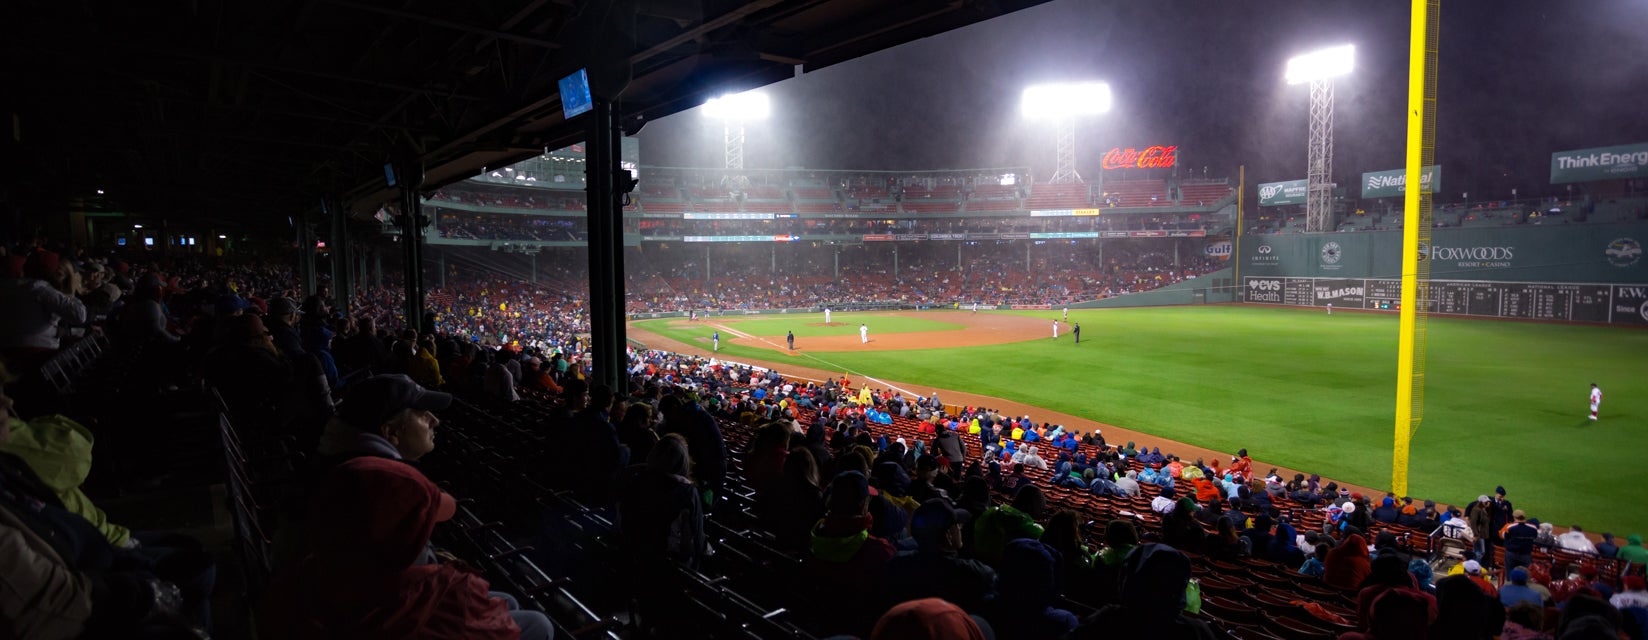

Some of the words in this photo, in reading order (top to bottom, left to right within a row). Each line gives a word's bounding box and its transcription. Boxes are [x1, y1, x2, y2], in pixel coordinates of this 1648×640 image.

[1206, 244, 1232, 255] Gulf
[1431, 246, 1513, 260] FOXWOODS
[1258, 279, 1281, 291] CVS
[1249, 290, 1280, 302] Health
[1616, 305, 1636, 313] Since
